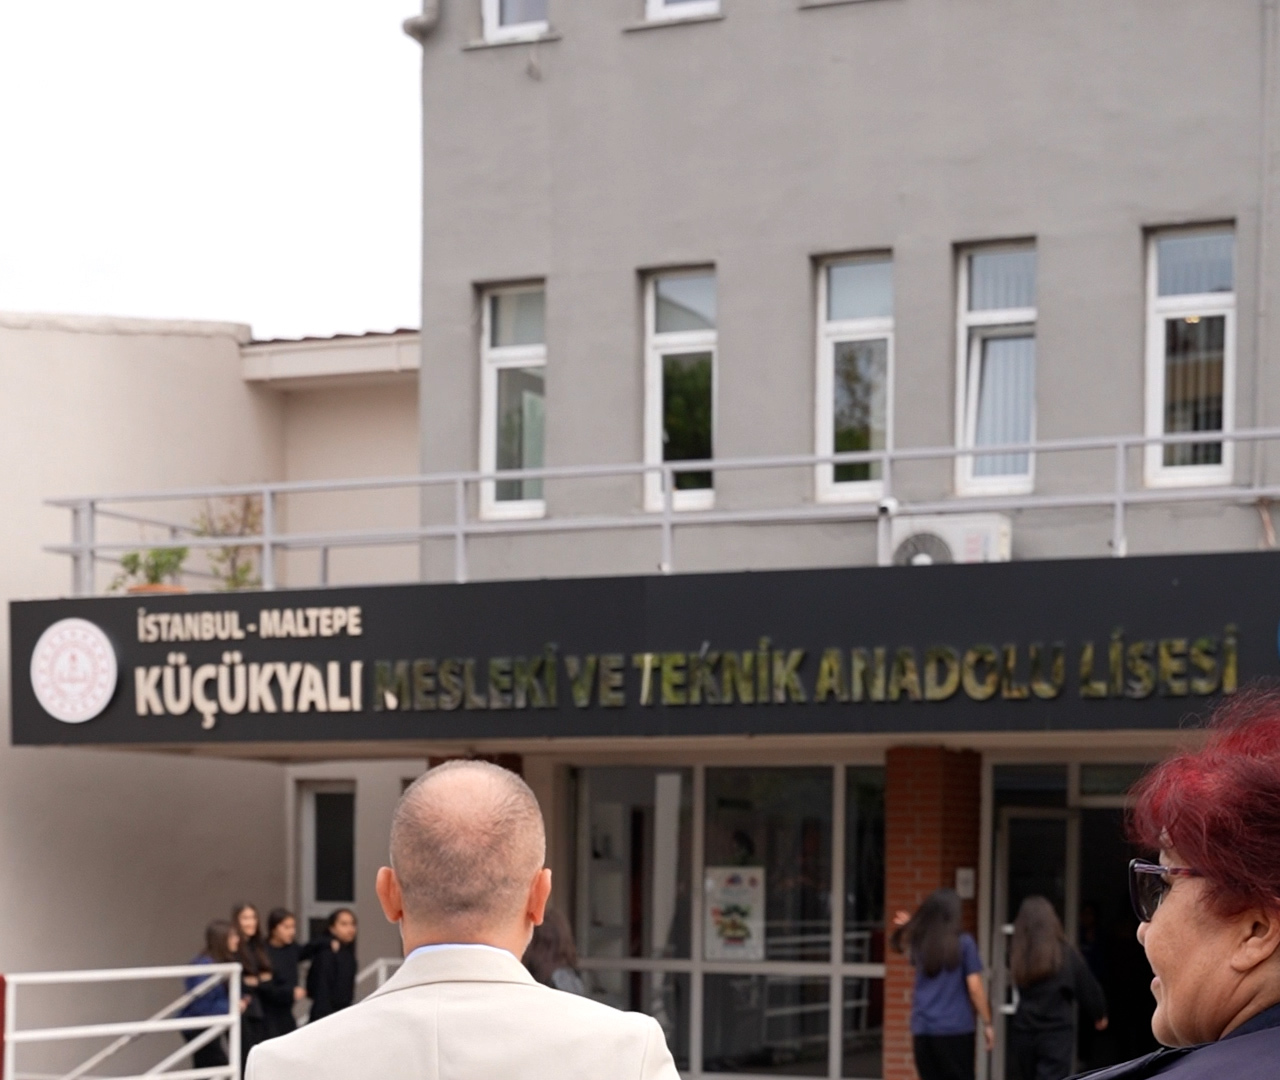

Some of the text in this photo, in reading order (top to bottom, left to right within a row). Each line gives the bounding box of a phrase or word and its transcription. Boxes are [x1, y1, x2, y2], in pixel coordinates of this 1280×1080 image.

[137, 606, 245, 643] İSTANBUL
[259, 606, 362, 639] MALTEPE
[134, 622, 1239, 729] KÜÇÜKYALI MESLEKİ VE TEKNİK ANADOLU LİSESİ
